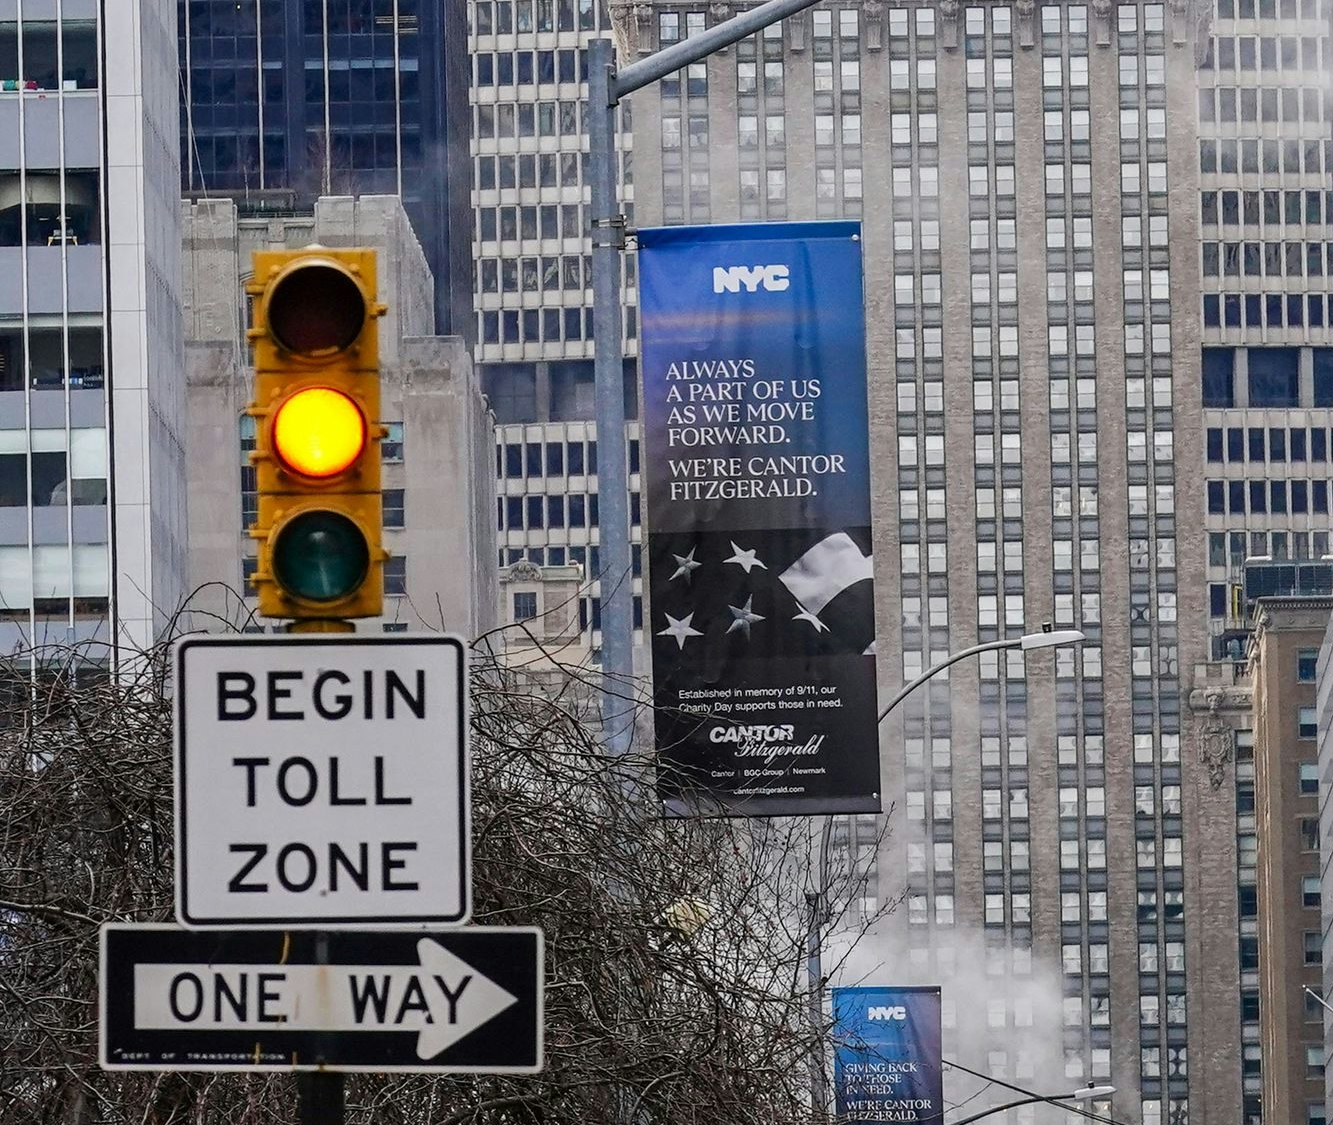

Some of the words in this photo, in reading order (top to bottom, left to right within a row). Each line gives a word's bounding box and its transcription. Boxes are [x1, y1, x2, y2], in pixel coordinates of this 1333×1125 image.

[713, 264, 789, 293] NYC
[666, 359, 755, 380] ALWAYS
[666, 385, 683, 402] A
[689, 381, 747, 401] PART
[752, 380, 784, 400] OF
[791, 379, 821, 399] US
[667, 405, 696, 425] AS
[702, 403, 741, 423] WE
[747, 402, 815, 422] MOVE
[668, 425, 791, 447] FORWARD.
[669, 457, 742, 478] WE'RE
[748, 454, 846, 475] CANTOR
[670, 478, 818, 500] FITZGERALD.
[216, 669, 426, 721] BEGIN
[678, 689, 731, 699] Established
[734, 688, 742, 697] in
[745, 689, 782, 699] memory
[785, 687, 795, 696] of
[797, 685, 818, 696] 9/11,
[679, 701, 713, 713] Charity
[714, 701, 733, 713] Day
[735, 701, 776, 712] supports
[779, 699, 803, 709] those
[806, 698, 814, 707] in
[817, 698, 843, 708] need.
[709, 725, 794, 743] CANTOR
[734, 734, 825, 763] Fitzgerald
[232, 756, 413, 807] TOLL
[793, 766, 826, 775] Newmark
[228, 841, 419, 893] ZONE
[169, 972, 288, 1024] ONE
[349, 974, 472, 1025] WAY
[868, 1006, 906, 1020] NYC
[845, 1063, 885, 1073] GIVING
[889, 1062, 917, 1072] BACK
[885, 1100, 931, 1109] CANTOR
